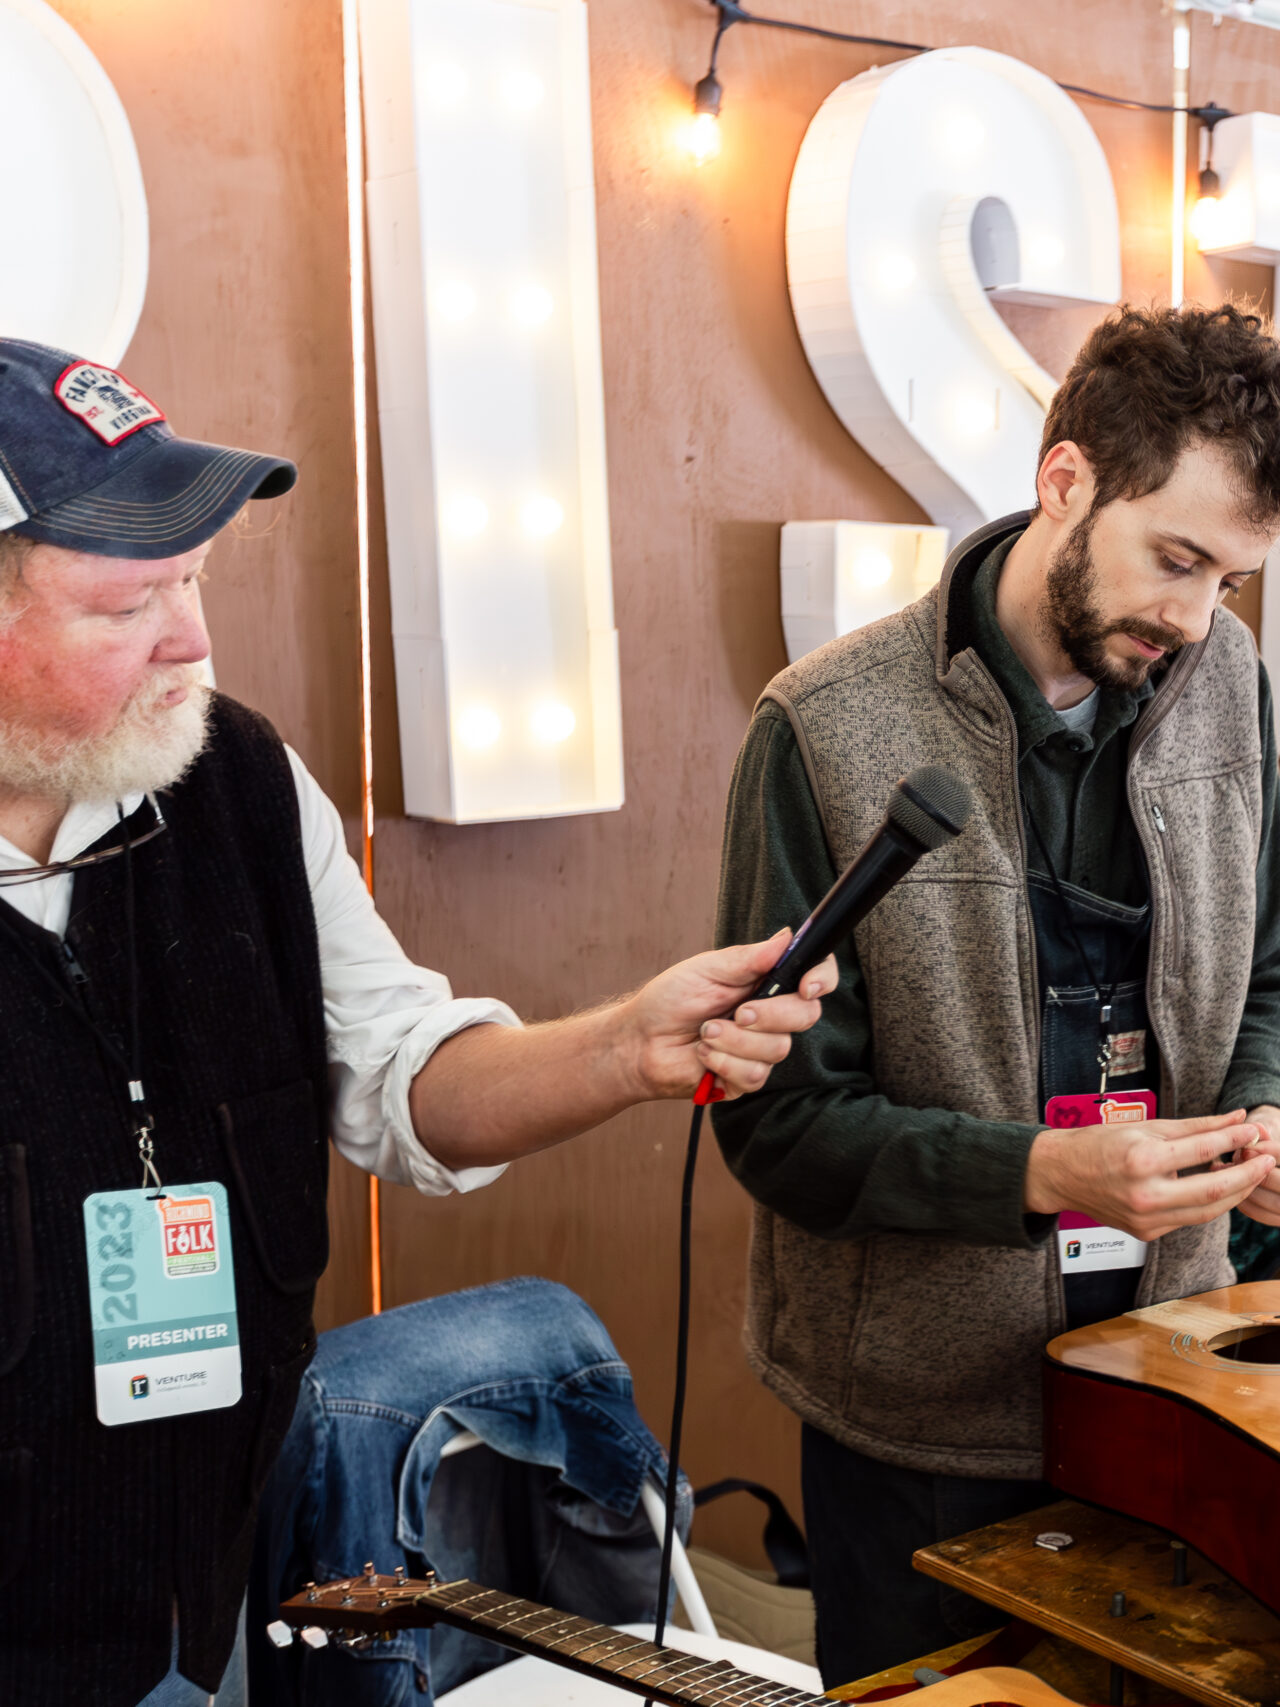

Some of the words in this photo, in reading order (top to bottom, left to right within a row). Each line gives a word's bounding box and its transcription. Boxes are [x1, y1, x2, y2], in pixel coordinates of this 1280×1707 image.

[166, 1224, 213, 1254] FOLK
[1085, 1240, 1125, 1249] VENTURE
[96, 1202, 138, 1323] 2023
[127, 1323, 228, 1350] PRESENTER
[155, 1371, 207, 1385] VENTURE
